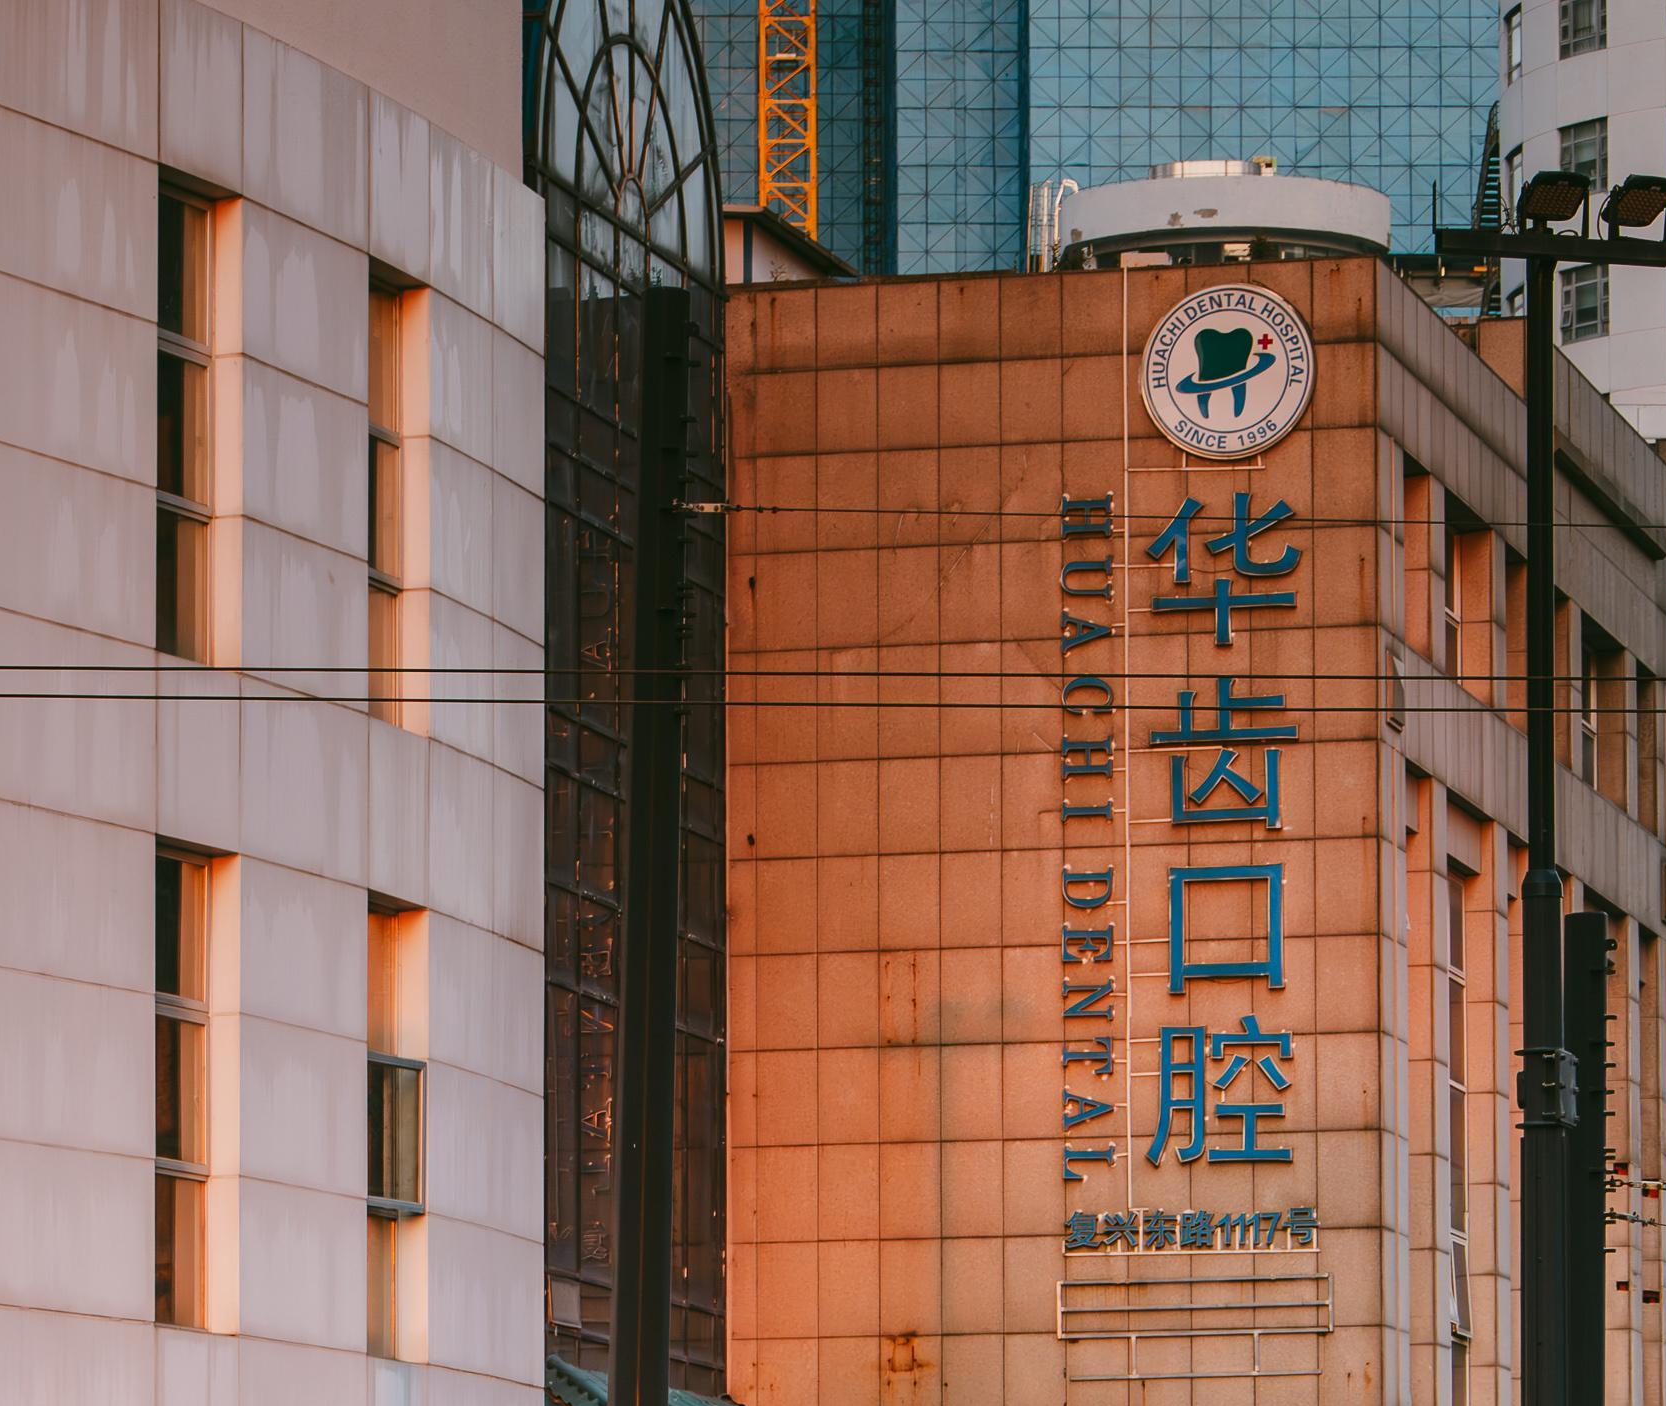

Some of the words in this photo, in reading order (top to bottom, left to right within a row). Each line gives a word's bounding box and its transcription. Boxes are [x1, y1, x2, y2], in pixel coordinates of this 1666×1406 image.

[1152, 316, 1187, 389] HUACHI
[1187, 293, 1258, 322] DENTAL
[1260, 302, 1306, 388] HOSPITAL
[1174, 420, 1227, 450] SINCE
[1237, 418, 1278, 446] 1996
[1059, 491, 1115, 823] HUACHI
[1145, 490, 1303, 1167] 华齿口腔
[1061, 863, 1116, 1183] DENTAL
[1064, 1207, 1321, 1249] 复兴东路1117号
